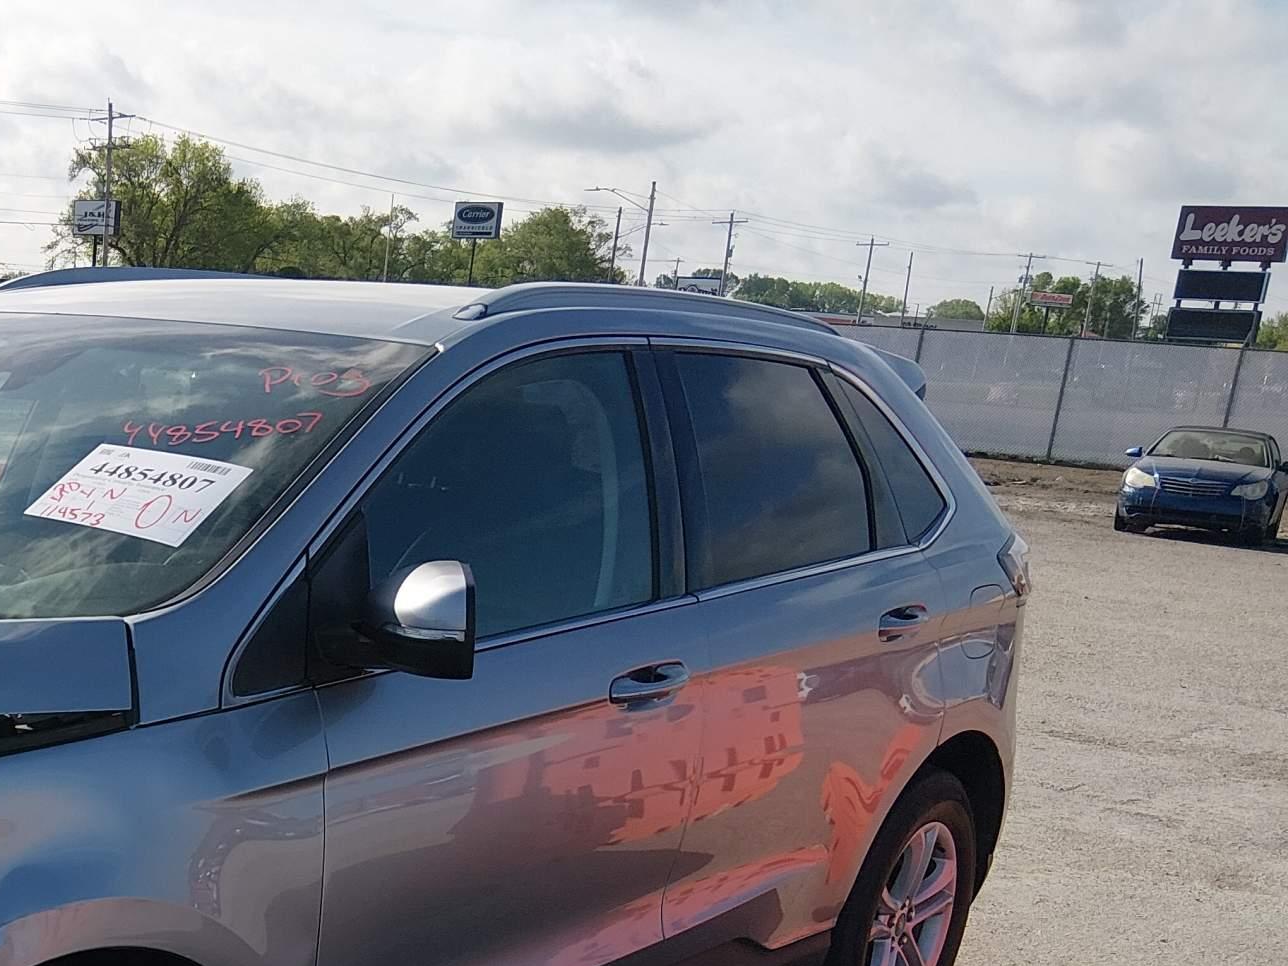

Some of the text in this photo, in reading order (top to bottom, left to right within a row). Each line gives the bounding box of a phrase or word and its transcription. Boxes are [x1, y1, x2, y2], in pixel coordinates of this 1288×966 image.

[463, 210, 490, 218] Carrier
[1179, 213, 1286, 243] Leeker's
[1182, 245, 1275, 256] FAMILY FOODS
[123, 412, 324, 446] 44854807
[90, 462, 216, 493] 44854807
